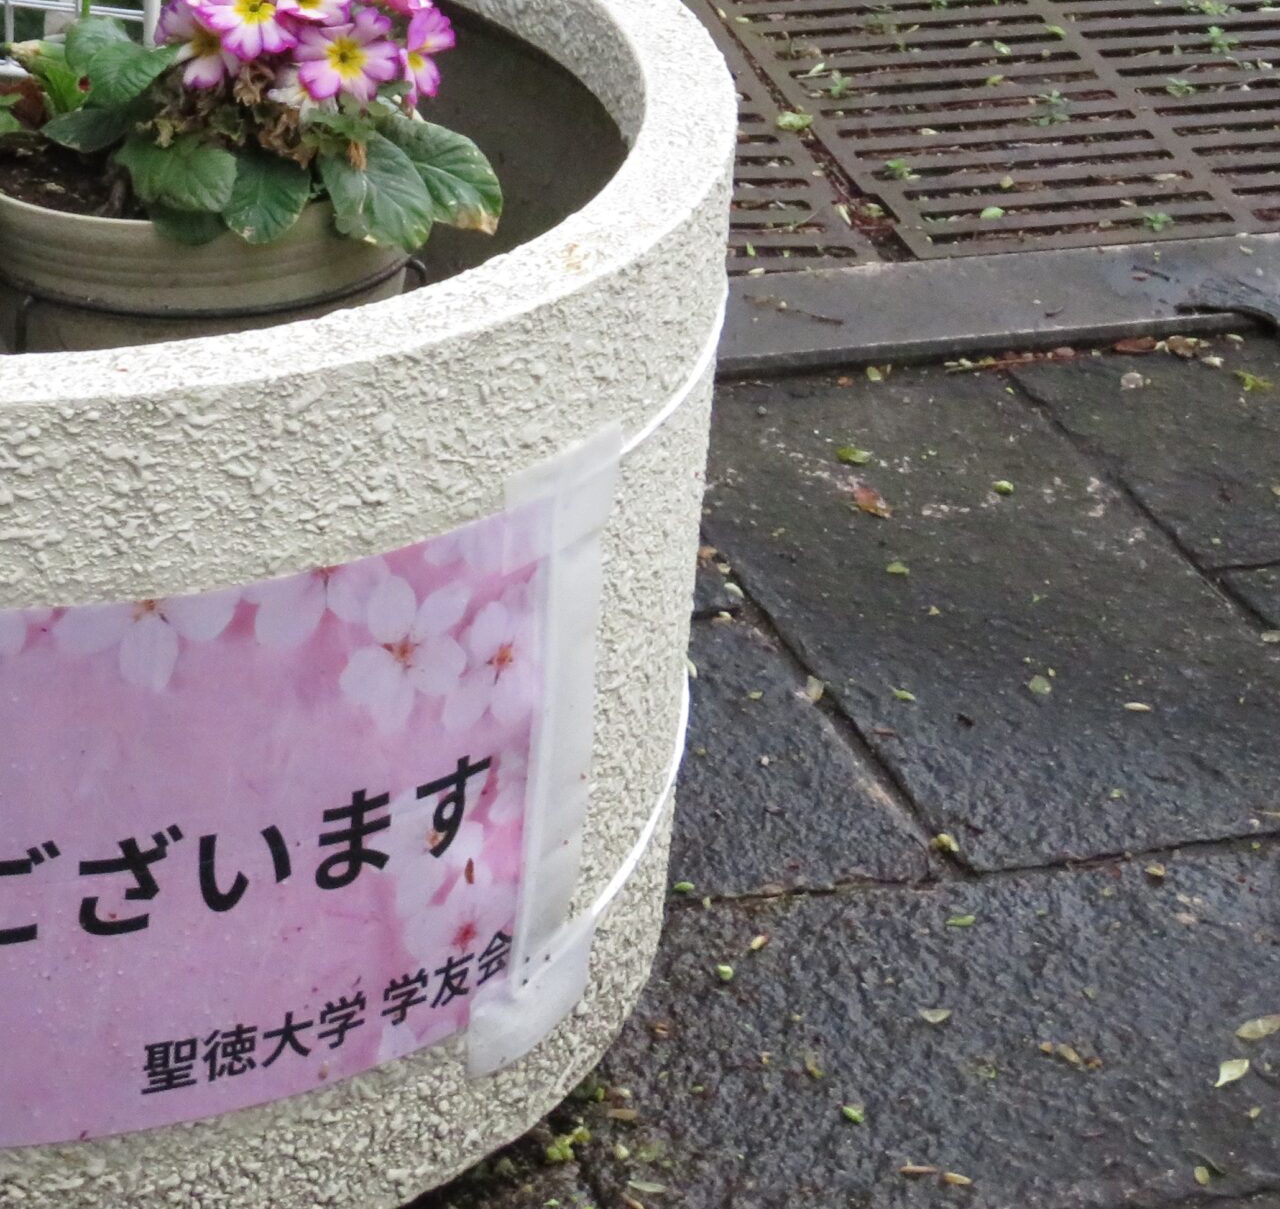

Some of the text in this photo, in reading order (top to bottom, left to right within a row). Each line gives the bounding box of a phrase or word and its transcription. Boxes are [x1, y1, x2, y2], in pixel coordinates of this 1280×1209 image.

[141, 930, 513, 1095] 聖徳大学 学友会
